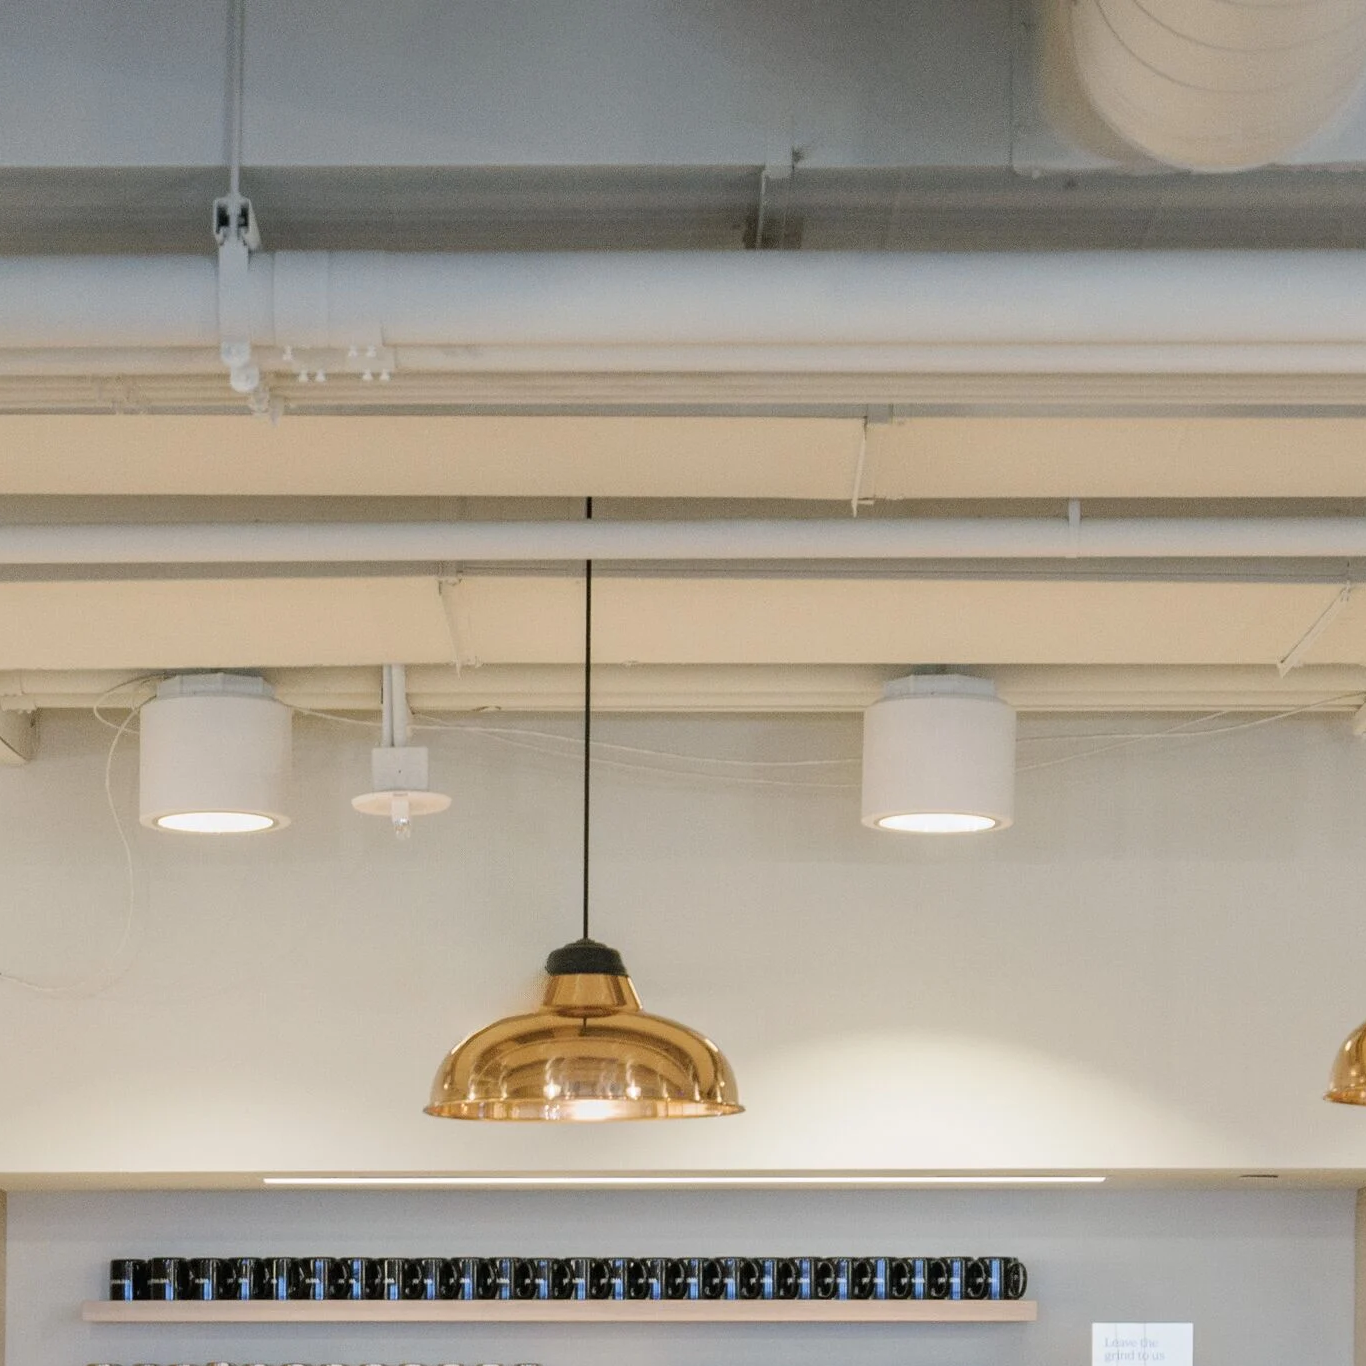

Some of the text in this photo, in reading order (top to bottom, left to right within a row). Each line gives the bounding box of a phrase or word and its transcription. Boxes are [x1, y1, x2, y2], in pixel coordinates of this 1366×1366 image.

[1105, 1338, 1159, 1348] Leave the
[1105, 1350, 1165, 1363] grind to us
